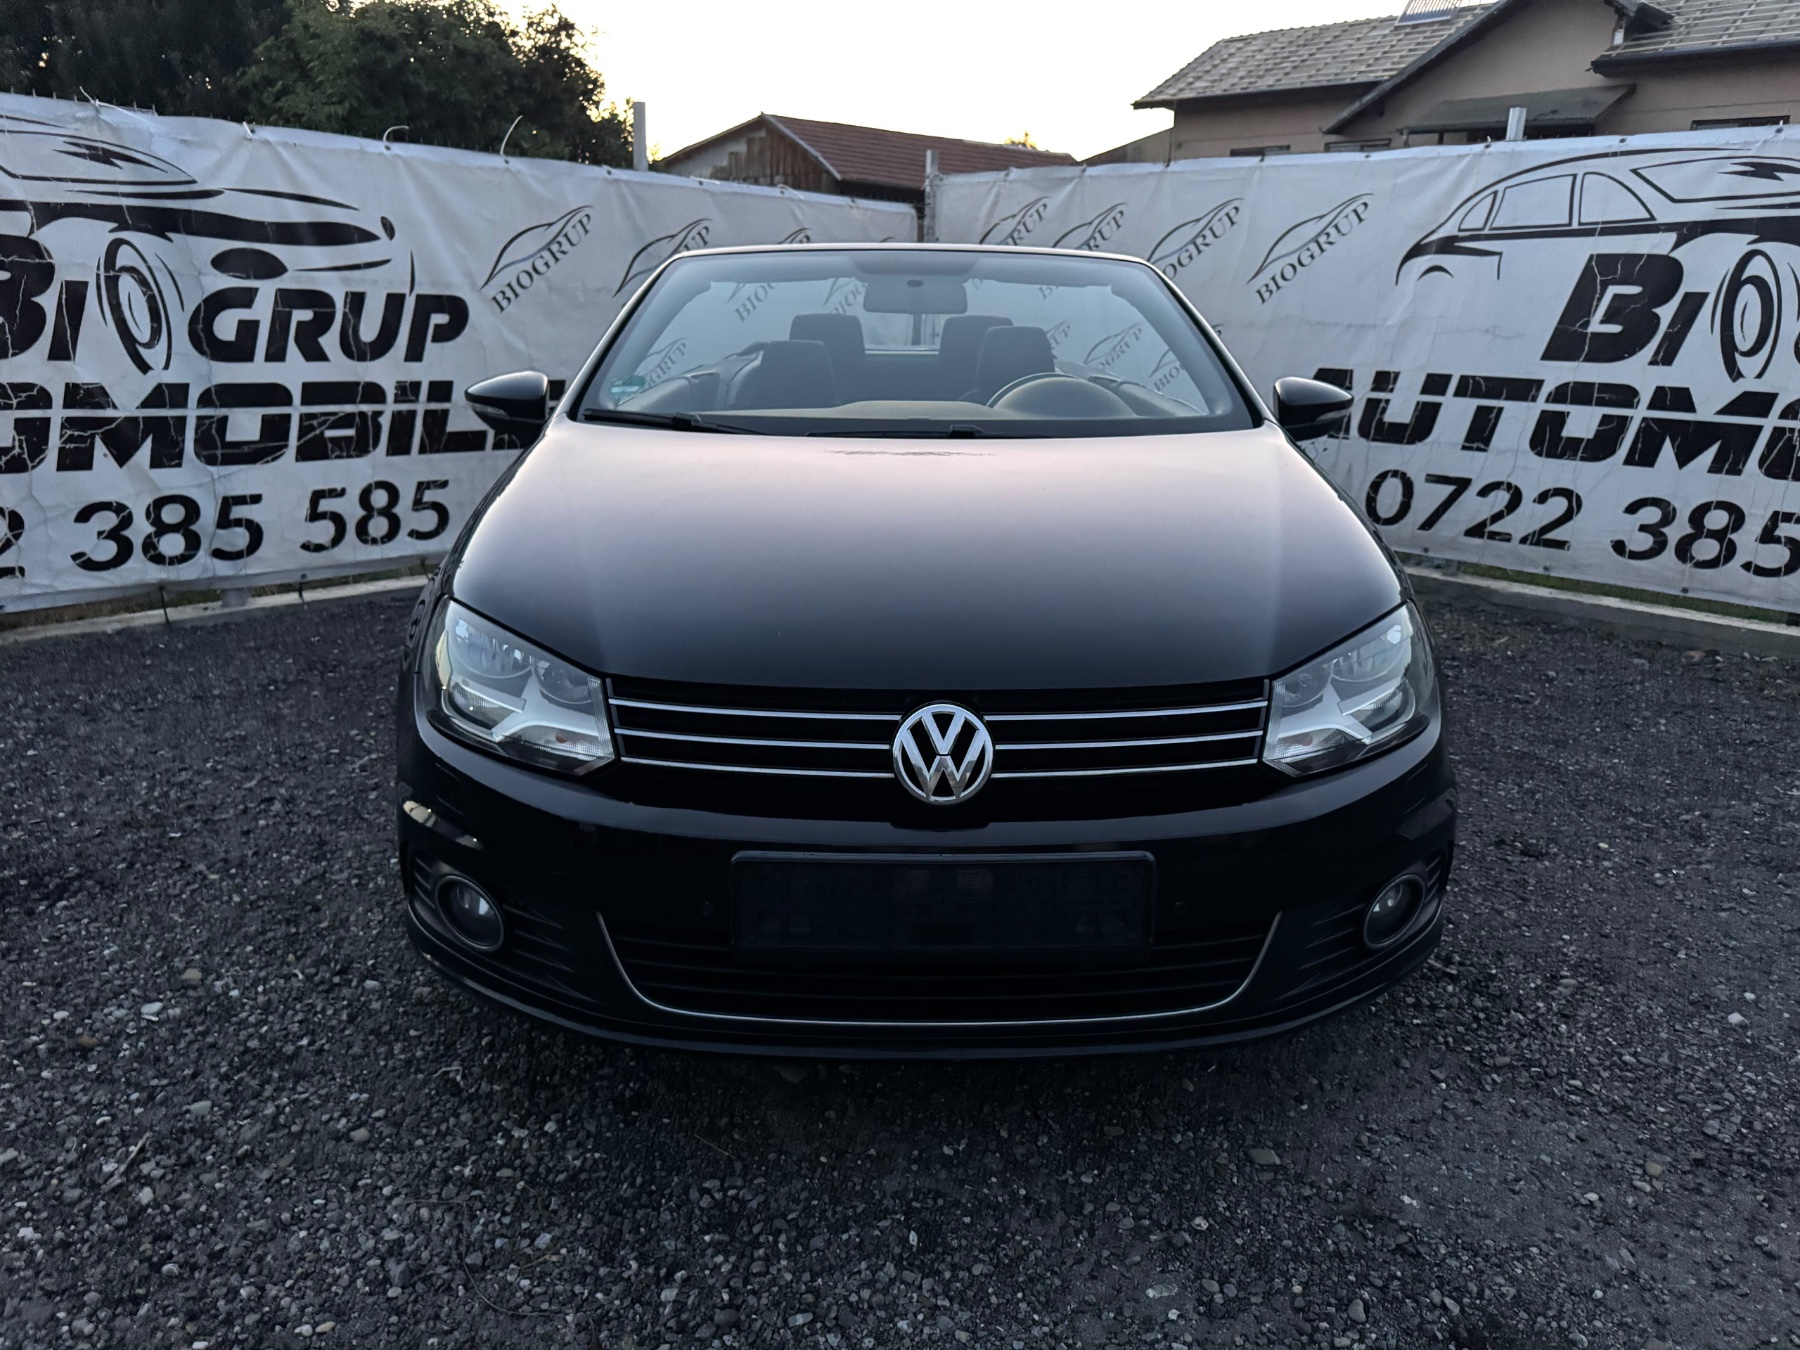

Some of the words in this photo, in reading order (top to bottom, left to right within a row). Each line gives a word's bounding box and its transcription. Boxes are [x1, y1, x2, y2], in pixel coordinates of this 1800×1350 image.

[490, 213, 592, 313] BIOGRUP
[1163, 206, 1240, 281] OGRUP
[1254, 201, 1370, 305] BIOGRUP
[70, 494, 264, 572] 385
[300, 480, 450, 553] 585
[1366, 469, 1583, 551] 0722
[1611, 497, 1800, 577] 385
[892, 704, 993, 805] VW
